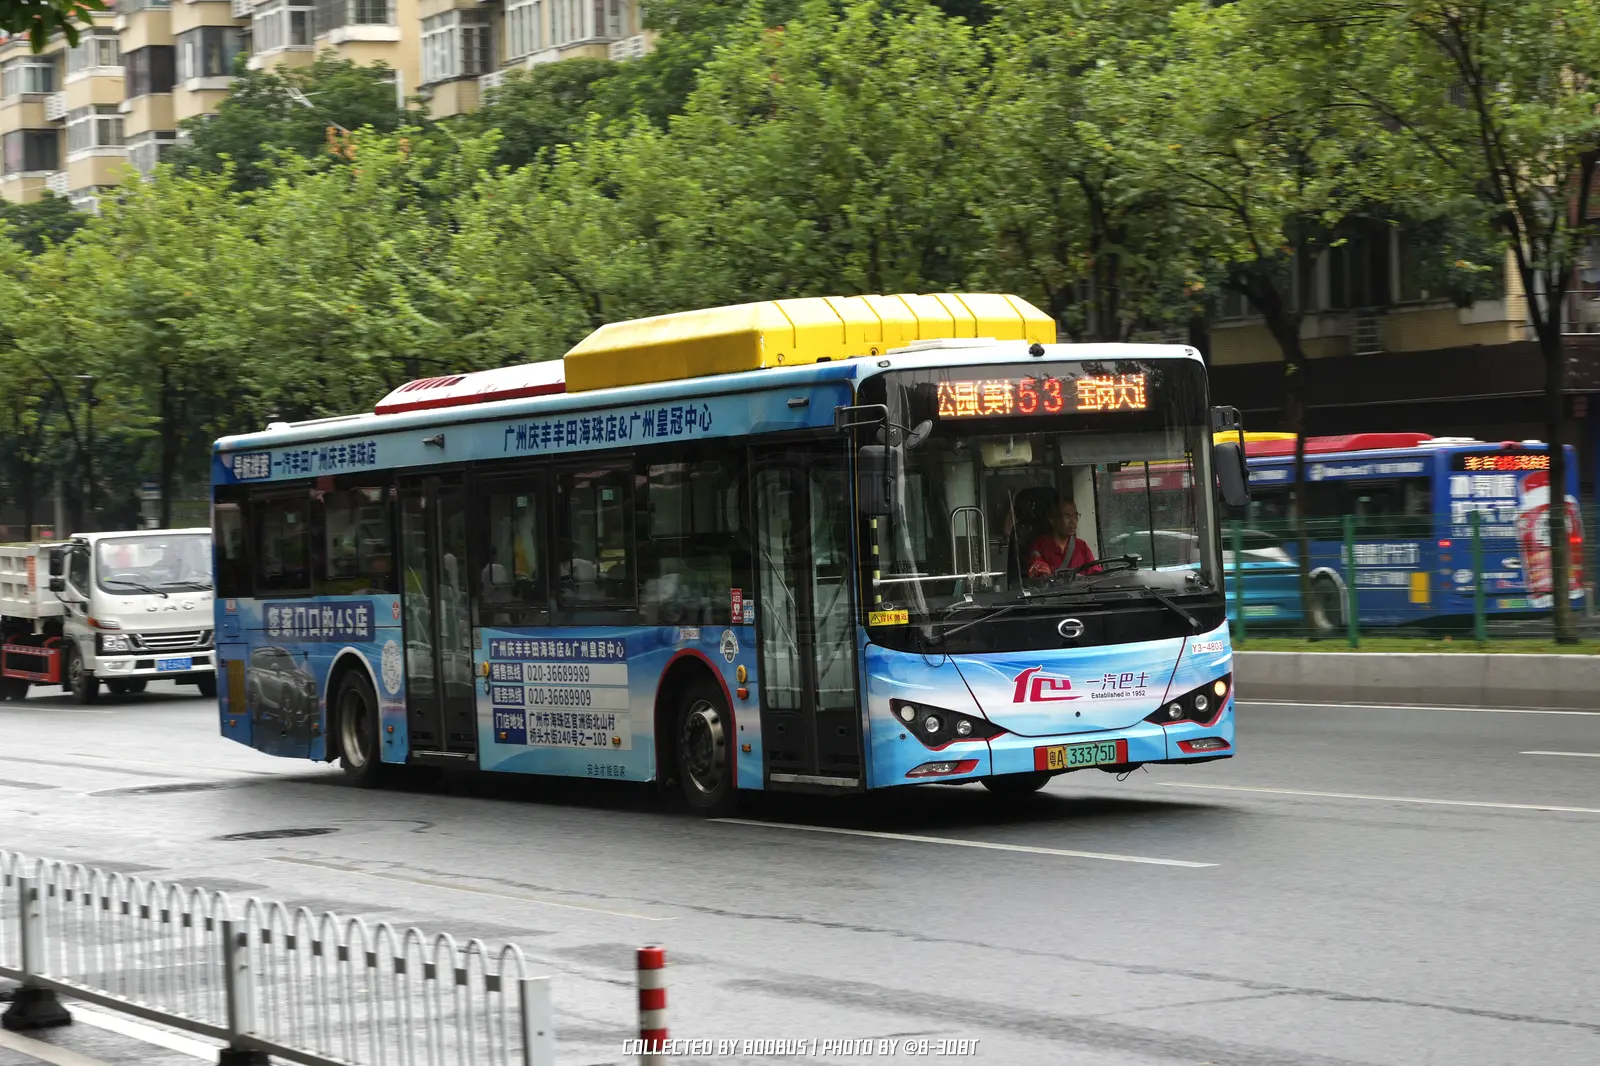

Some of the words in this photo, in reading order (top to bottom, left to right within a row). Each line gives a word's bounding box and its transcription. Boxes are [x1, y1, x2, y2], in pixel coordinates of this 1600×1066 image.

[1017, 377, 1065, 415] 53
[503, 403, 713, 452] 广州庆丰丰田海珠店&广州皇冠中心
[273, 440, 377, 474] 一汽丰田广州庆丰海珠店
[491, 641, 624, 659] 广州庆丰丰田海珠店&广州皇冠中心
[1191, 642, 1223, 653] Y3-4803
[527, 665, 590, 682] 020-36689989
[1086, 671, 1150, 690] 一汽巴士
[528, 689, 591, 707] 020-36689909
[1091, 689, 1124, 699] Established
[1132, 689, 1146, 697] 1952
[529, 711, 615, 731] 广州市海珠区官洲街北山村
[1069, 745, 1115, 764] 33375D
